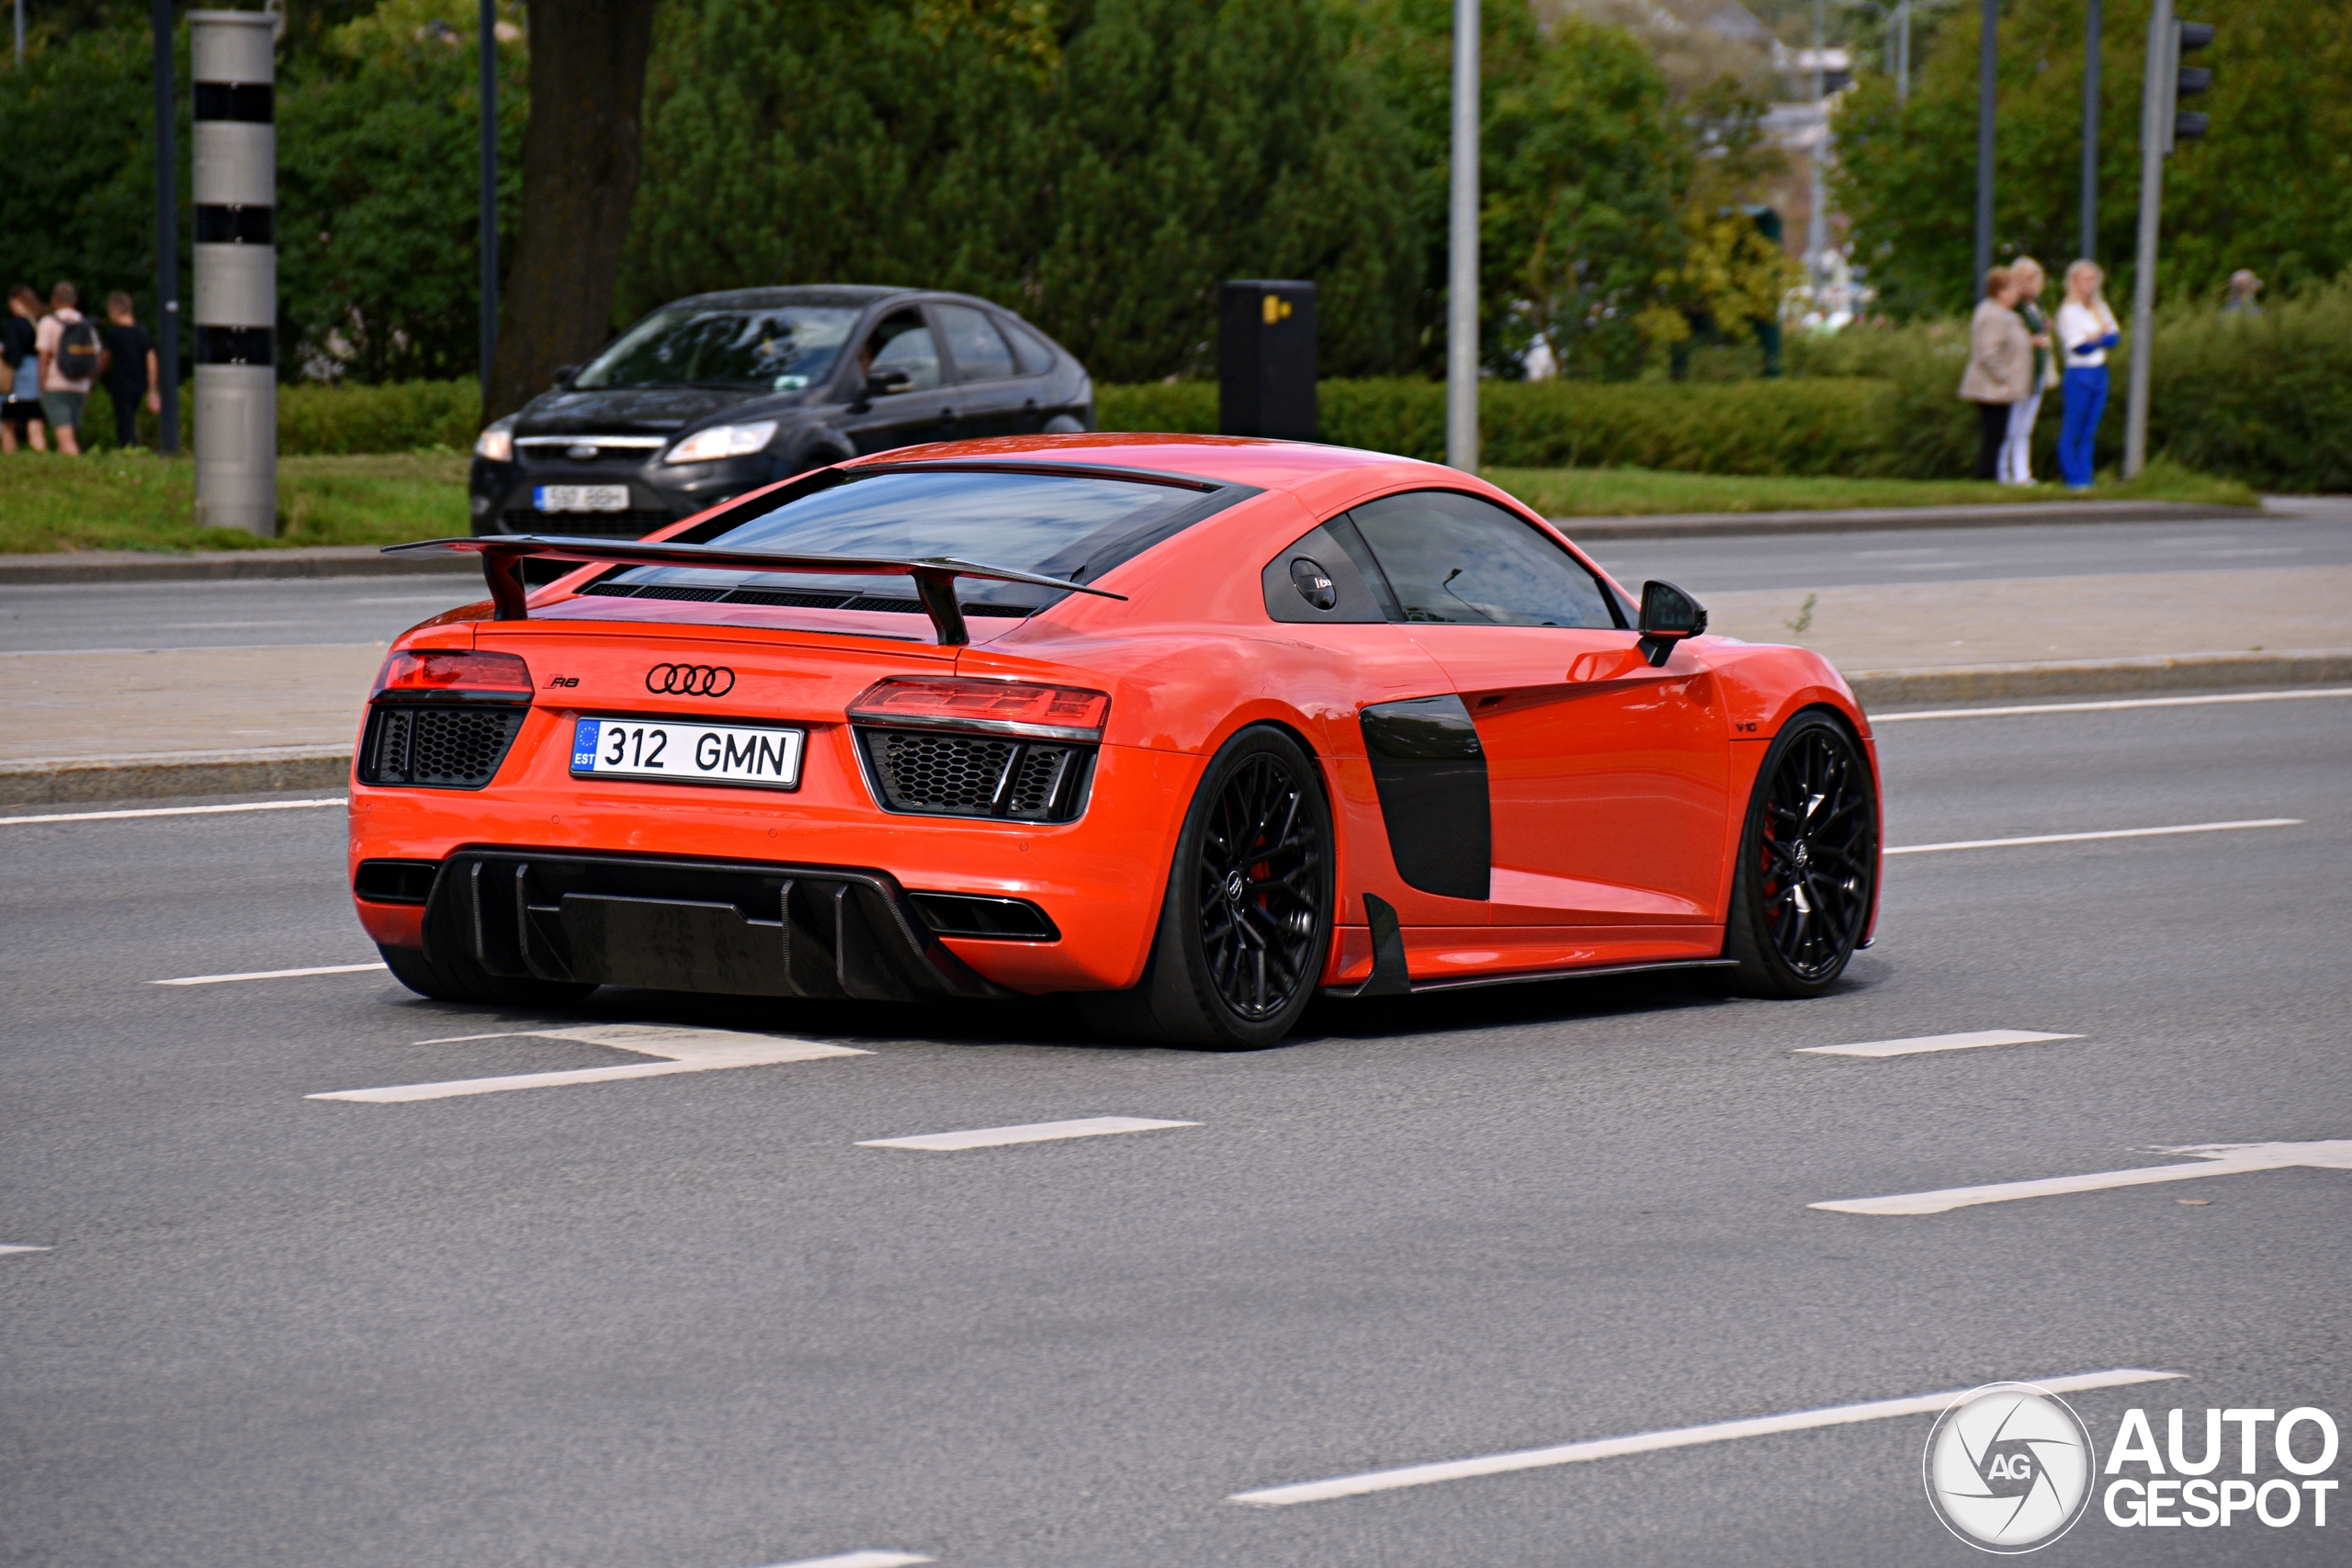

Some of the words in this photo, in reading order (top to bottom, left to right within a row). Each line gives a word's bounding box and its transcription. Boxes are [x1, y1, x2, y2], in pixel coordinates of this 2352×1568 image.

[549, 676, 580, 688] R8
[1736, 722, 1757, 732] V10
[605, 727, 667, 768] 312
[695, 732, 786, 775] GMN
[574, 753, 595, 765] EST
